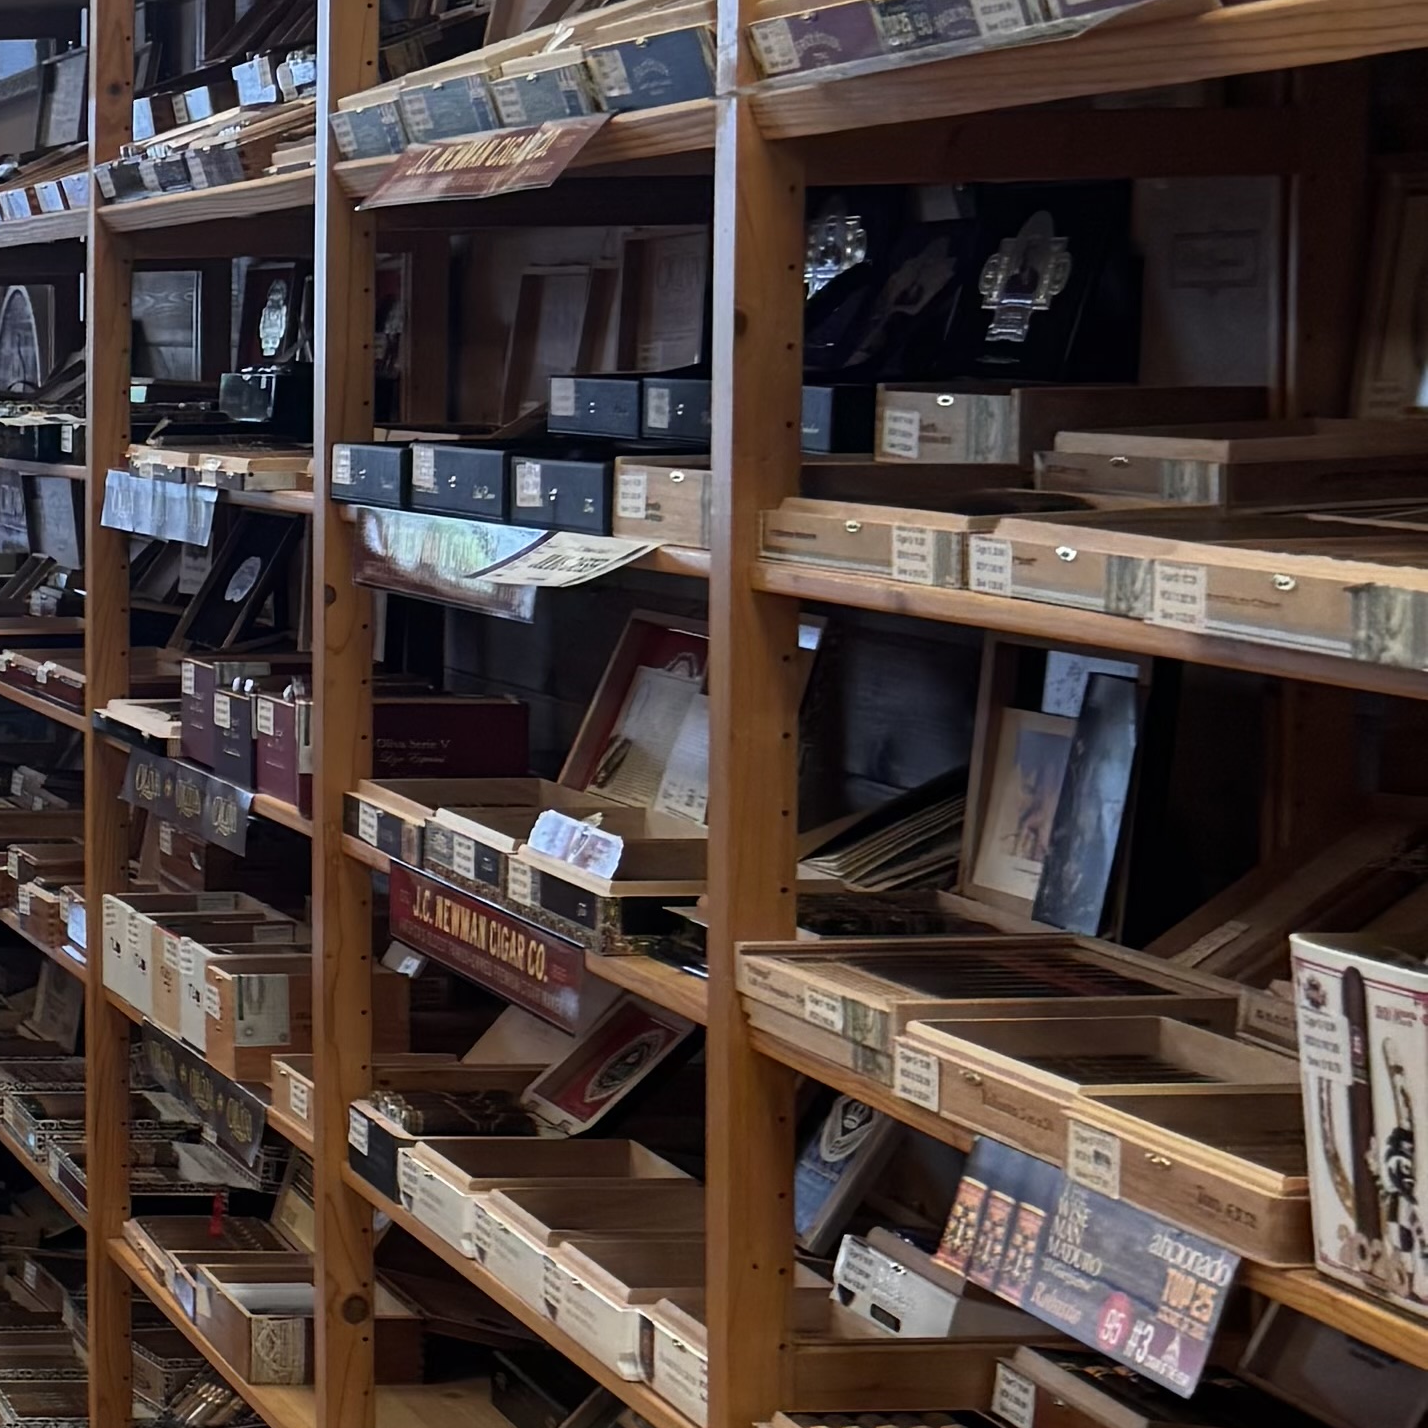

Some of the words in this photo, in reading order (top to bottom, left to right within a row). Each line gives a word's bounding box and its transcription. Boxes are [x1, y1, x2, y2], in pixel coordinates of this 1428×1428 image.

[413, 885, 433, 924] J.C.
[435, 894, 487, 950] NEWMAN
[489, 920, 525, 971] CIGAR
[527, 940, 548, 983] CO.
[1123, 1318, 1154, 1364] #3
